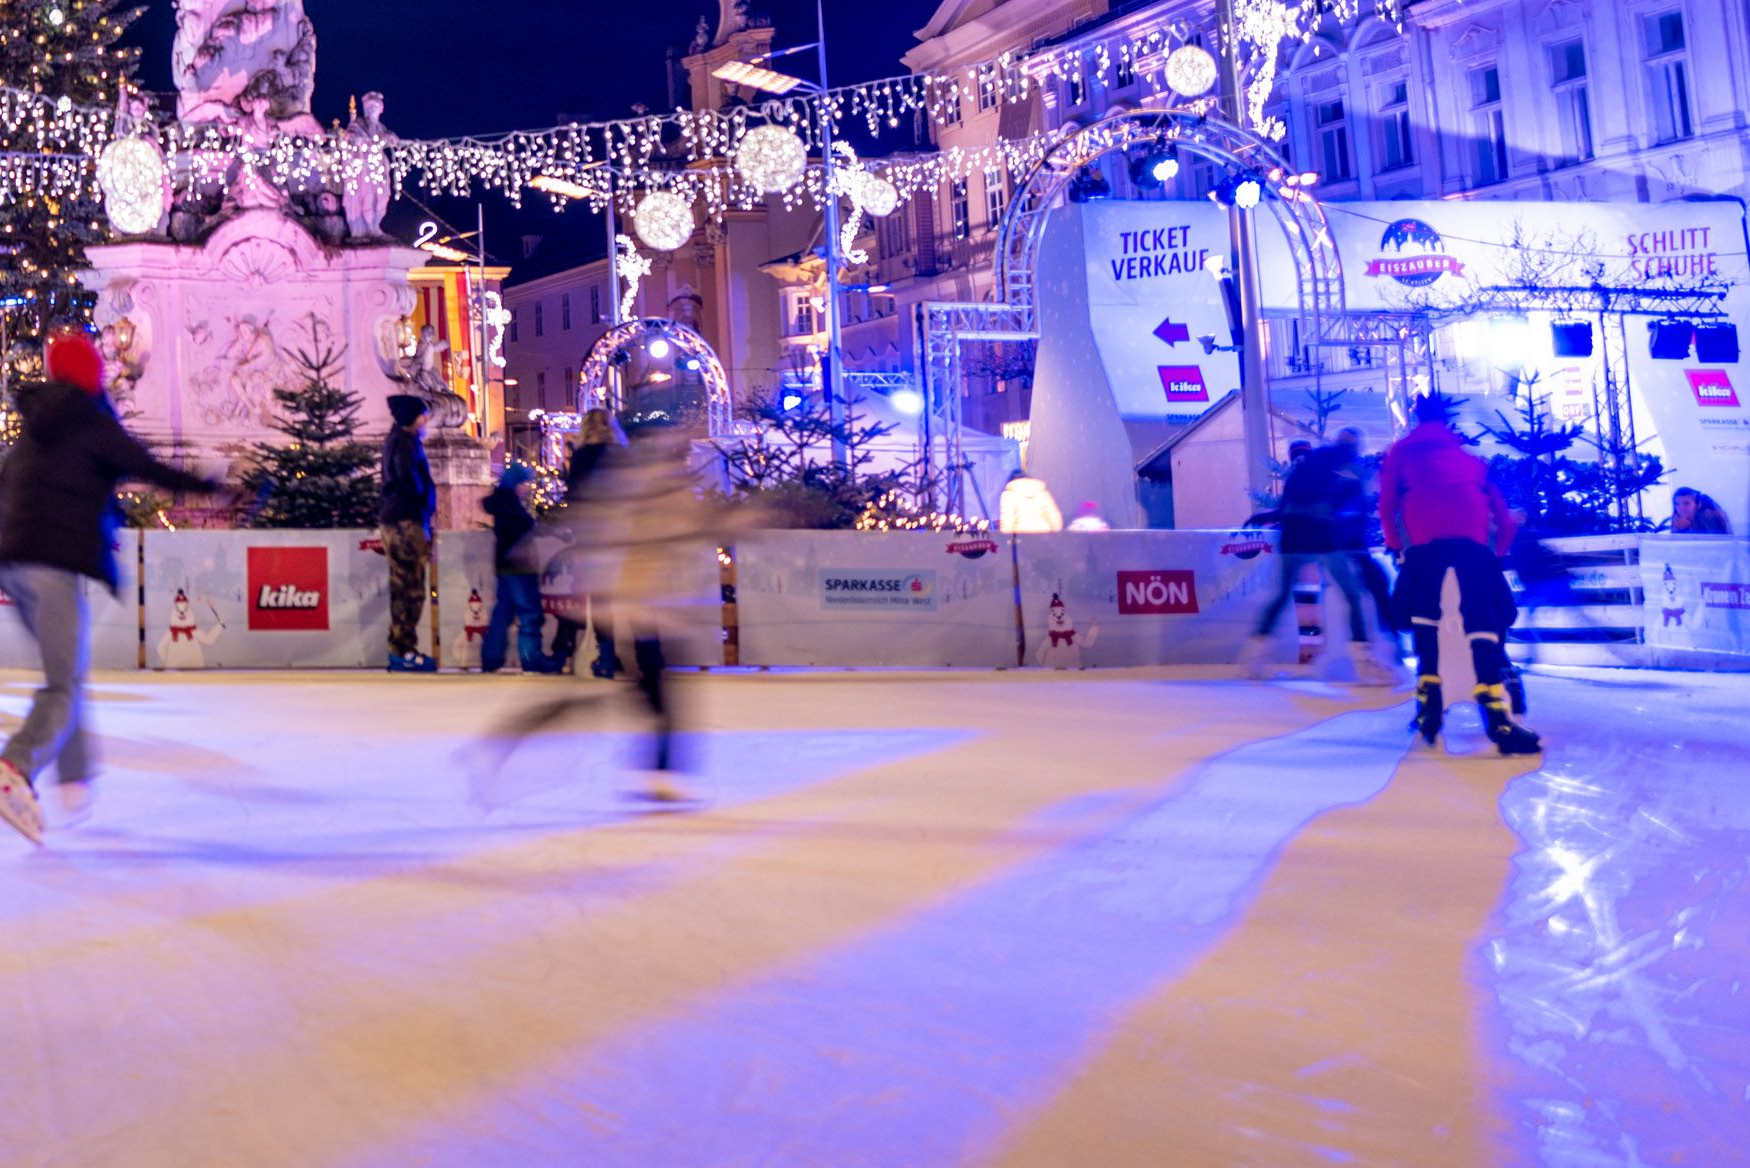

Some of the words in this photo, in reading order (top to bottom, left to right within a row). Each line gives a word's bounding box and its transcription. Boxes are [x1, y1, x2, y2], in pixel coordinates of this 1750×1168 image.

[1119, 225, 1191, 254] TICKET
[1627, 227, 1710, 255] SCHLITT
[1111, 248, 1209, 280] VERKAUF
[1379, 259, 1450, 273] EISZAUBER
[1631, 252, 1717, 281] SCHUHE
[1170, 381, 1202, 392] kika
[1697, 385, 1731, 397] kika
[259, 584, 321, 609] kika
[825, 579, 902, 592] SPARKASSE
[1126, 576, 1189, 606] NÖN
